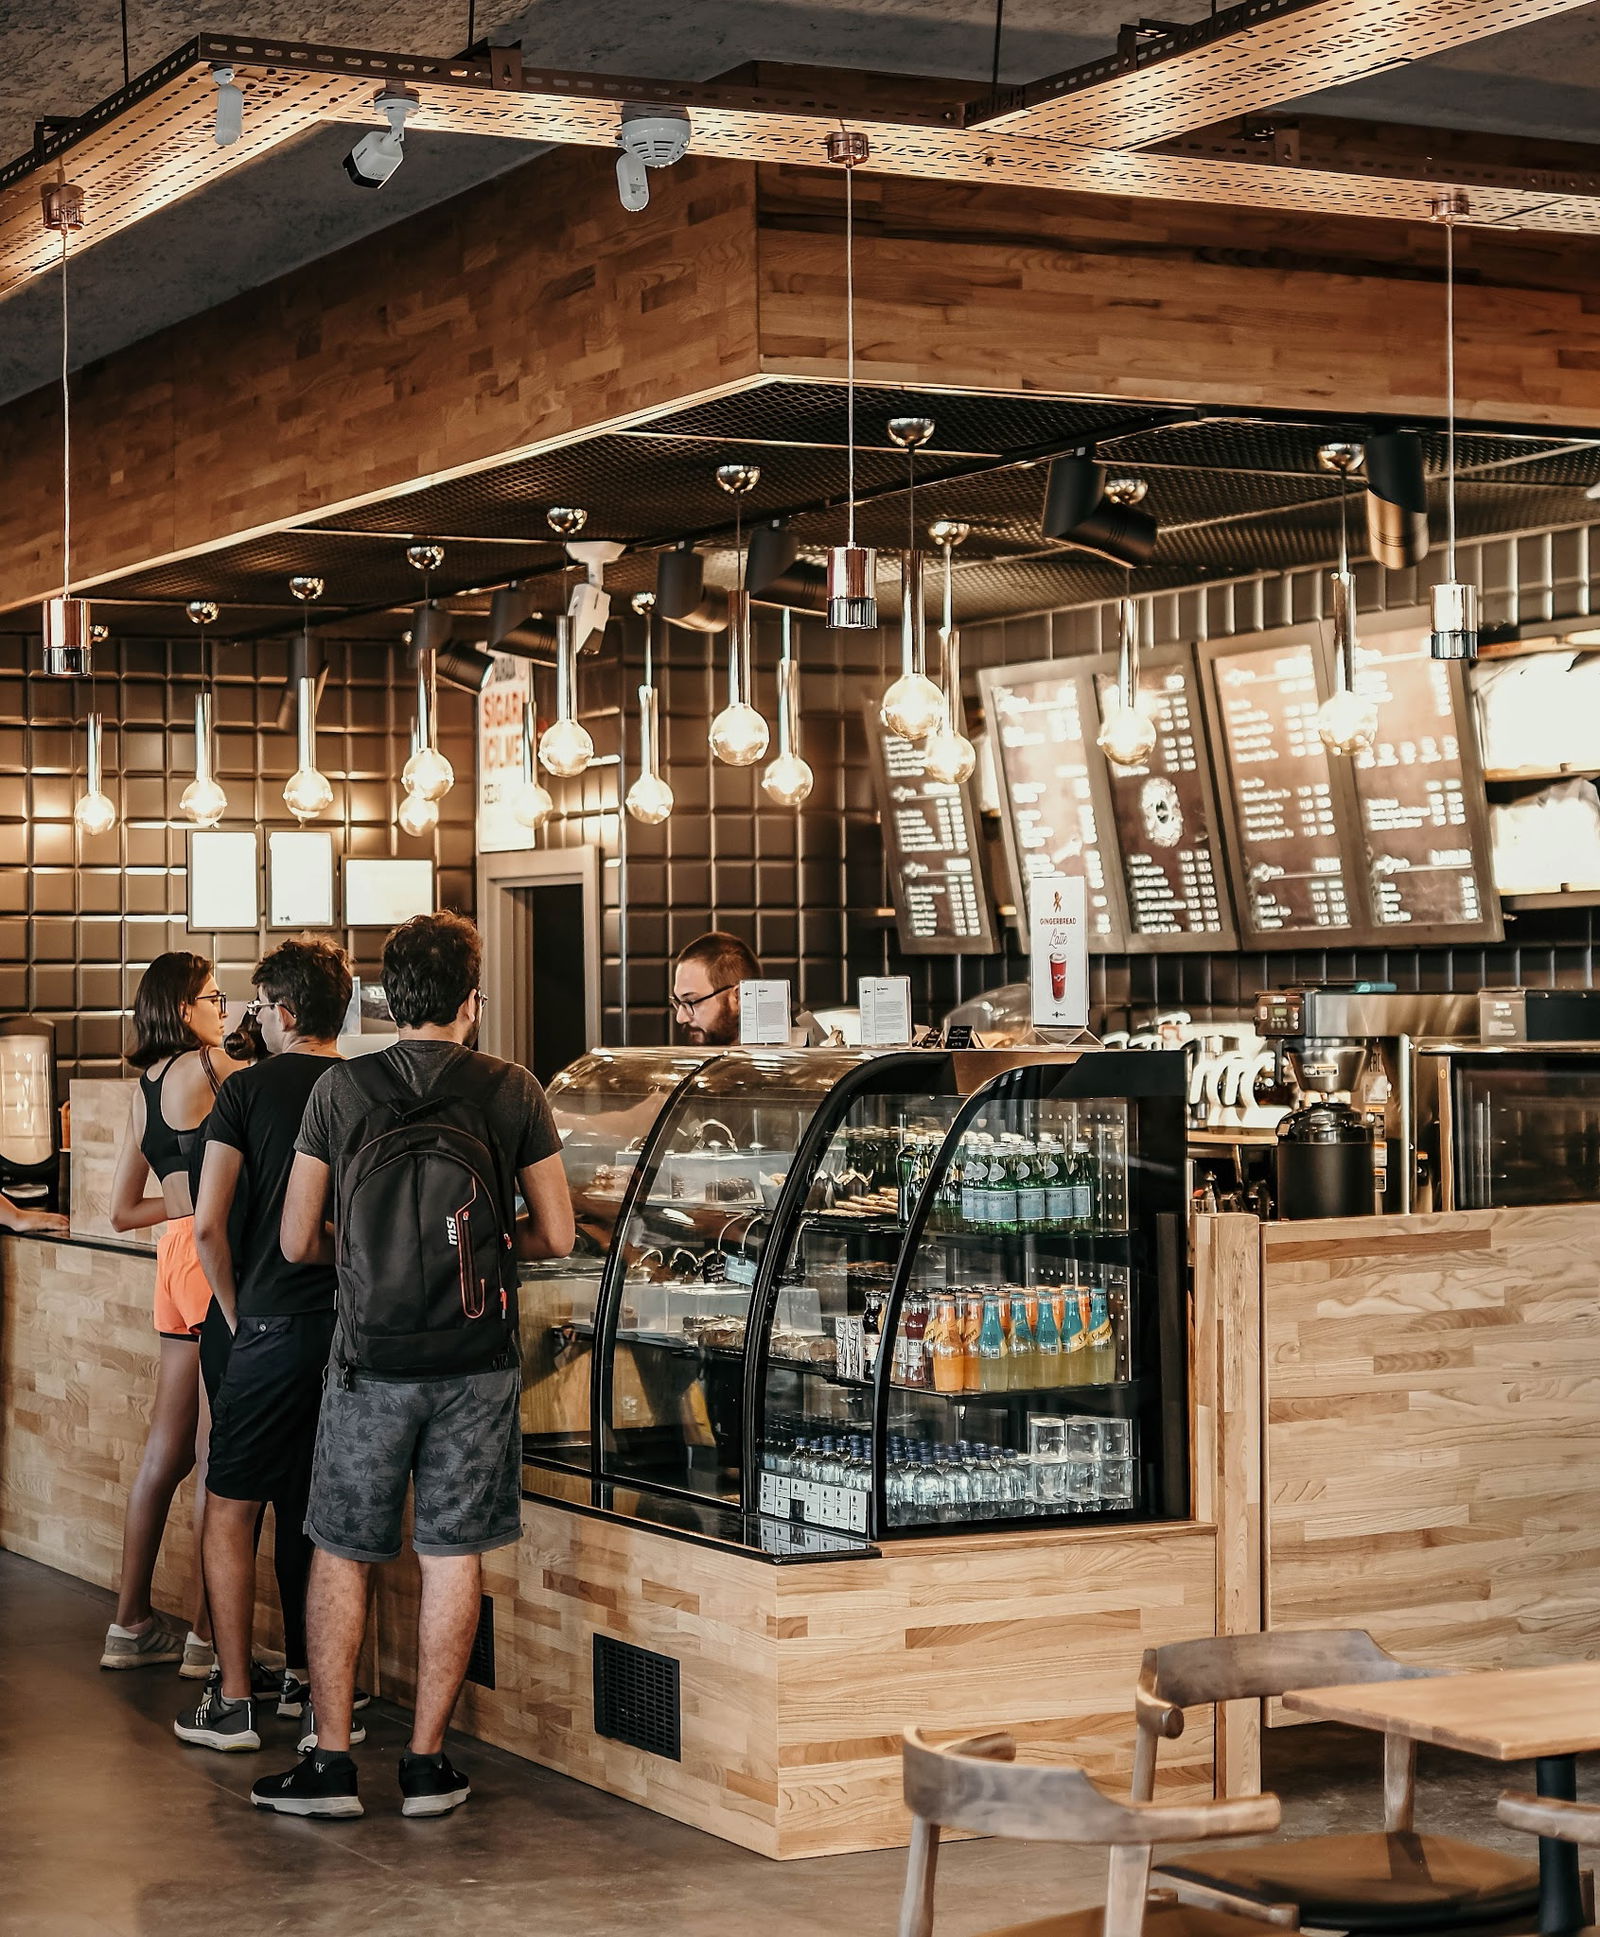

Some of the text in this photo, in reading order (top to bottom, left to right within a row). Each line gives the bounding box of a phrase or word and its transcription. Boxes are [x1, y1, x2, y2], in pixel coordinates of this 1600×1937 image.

[484, 690, 526, 728] SİGAR
[1039, 917, 1077, 925] GINGERBREAD
[1048, 927, 1068, 949] Latte
[446, 1216, 458, 1246] msi
